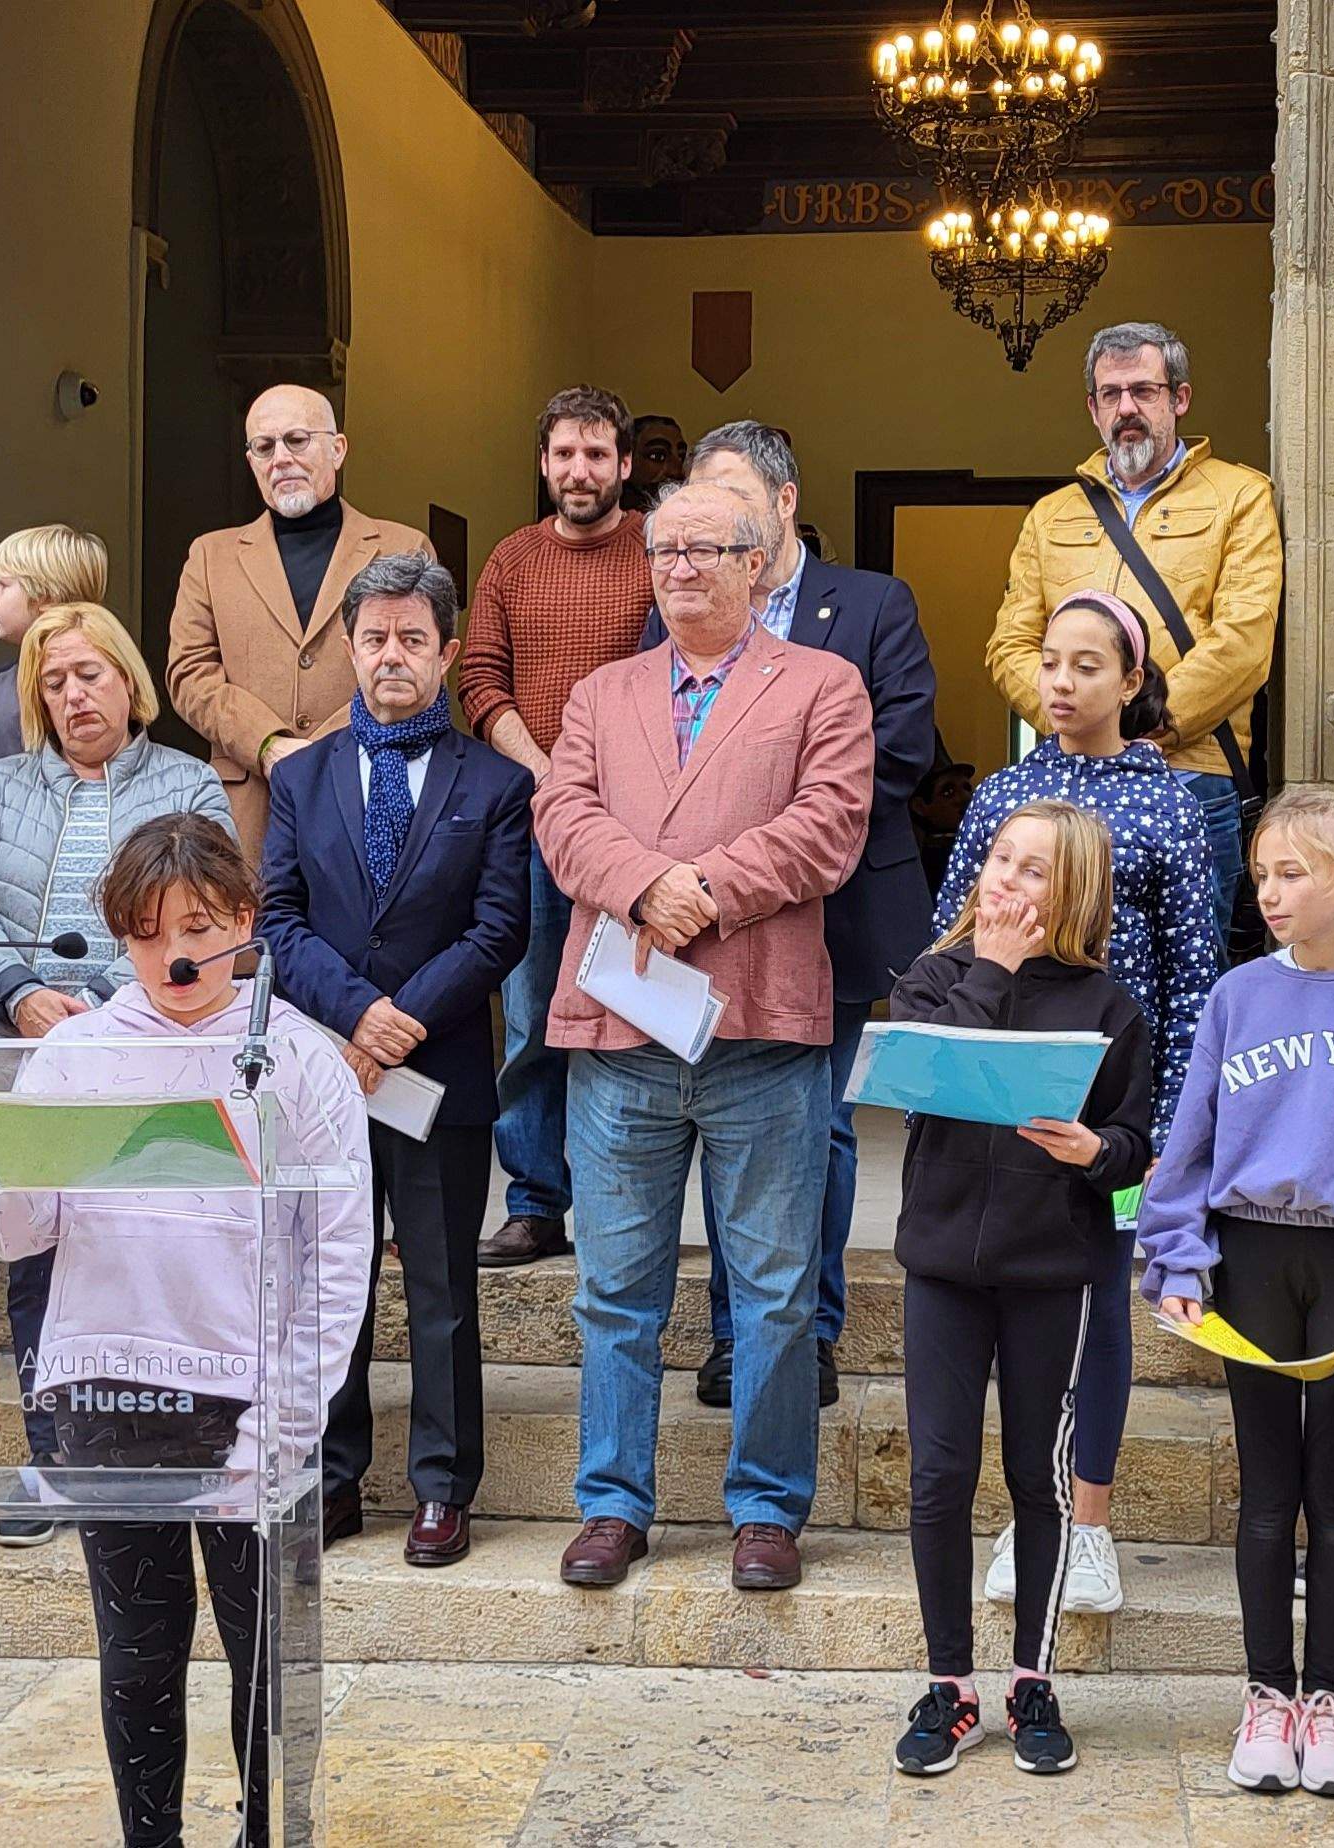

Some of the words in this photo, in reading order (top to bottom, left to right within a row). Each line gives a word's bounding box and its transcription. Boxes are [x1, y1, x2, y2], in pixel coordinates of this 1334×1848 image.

[1220, 1032, 1315, 1095] NEW
[18, 1345, 249, 1382] Ayuntamiento
[20, 1389, 57, 1412] de
[70, 1386, 195, 1414] Huesca
